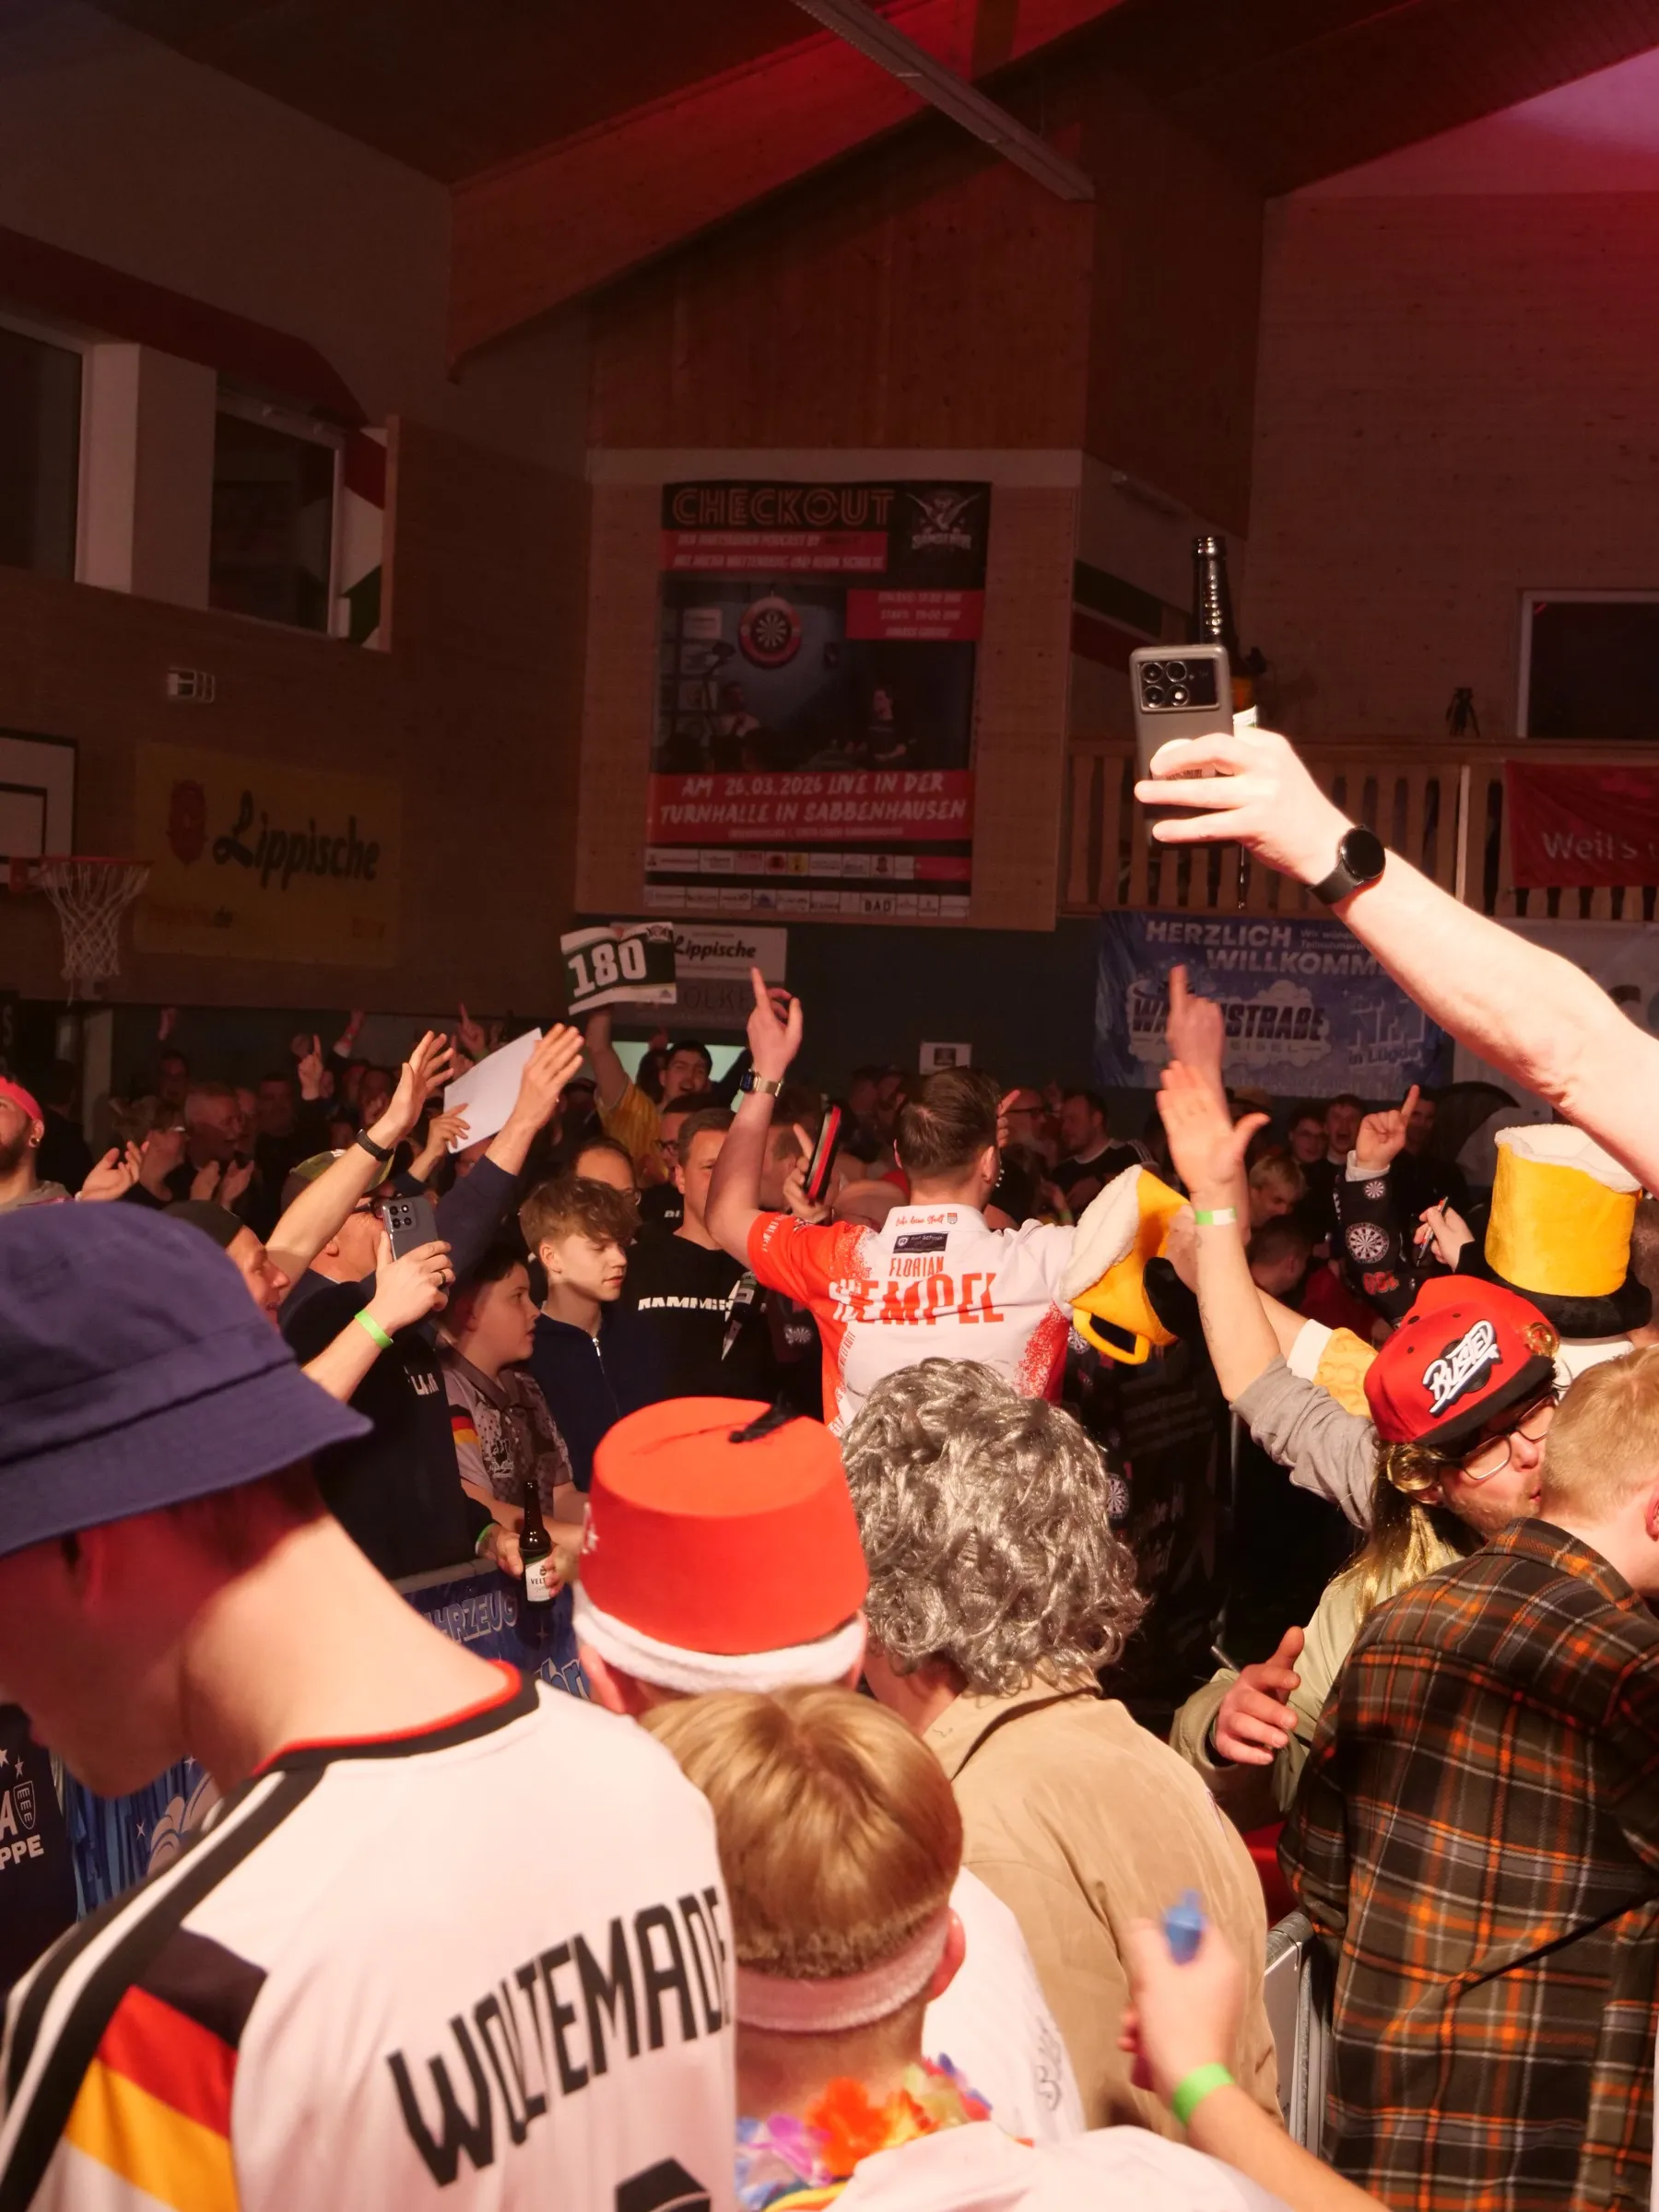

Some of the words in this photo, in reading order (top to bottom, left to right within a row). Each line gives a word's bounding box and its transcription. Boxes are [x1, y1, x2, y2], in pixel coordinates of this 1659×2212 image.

[673, 488, 895, 526] CHECKOUT
[682, 777, 713, 797] AM
[828, 775, 869, 795] LIVE
[874, 773, 897, 793] IN
[903, 772, 944, 793] DER
[661, 802, 771, 825] TURNHALLE
[775, 802, 798, 823] IN
[804, 799, 968, 823] SABBENHAUSEN
[213, 790, 381, 891] Lippische
[865, 900, 892, 912] BAD
[672, 935, 756, 961] Lippische
[1145, 921, 1292, 948] HERZLICH
[568, 938, 647, 997] 180
[1206, 947, 1385, 976] WILLKOMM
[888, 1256, 945, 1277] FLORIAN
[427, 1590, 518, 1642] HRZEUG
